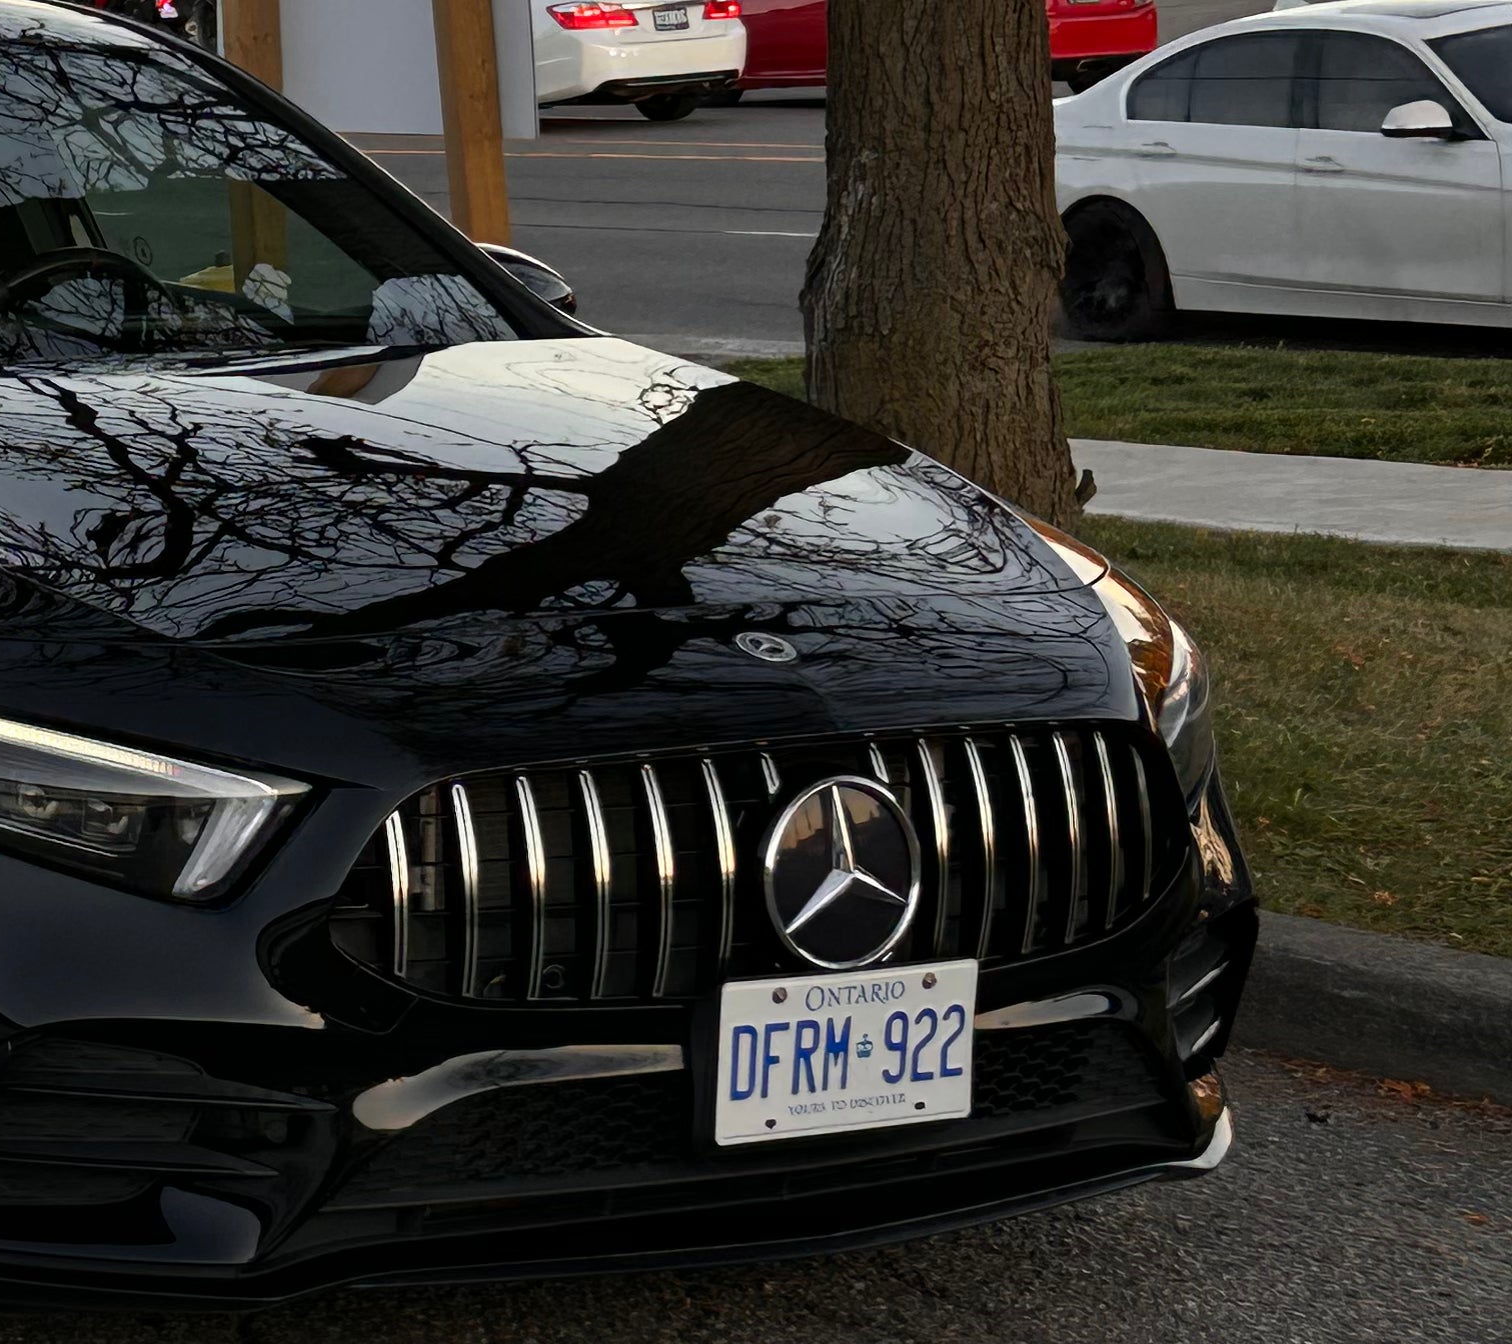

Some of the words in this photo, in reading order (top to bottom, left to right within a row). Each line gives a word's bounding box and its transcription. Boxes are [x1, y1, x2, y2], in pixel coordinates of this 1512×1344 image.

[805, 980, 906, 1011] ONTARIO
[730, 1015, 853, 1102] DFRM
[881, 1004, 966, 1084] 922
